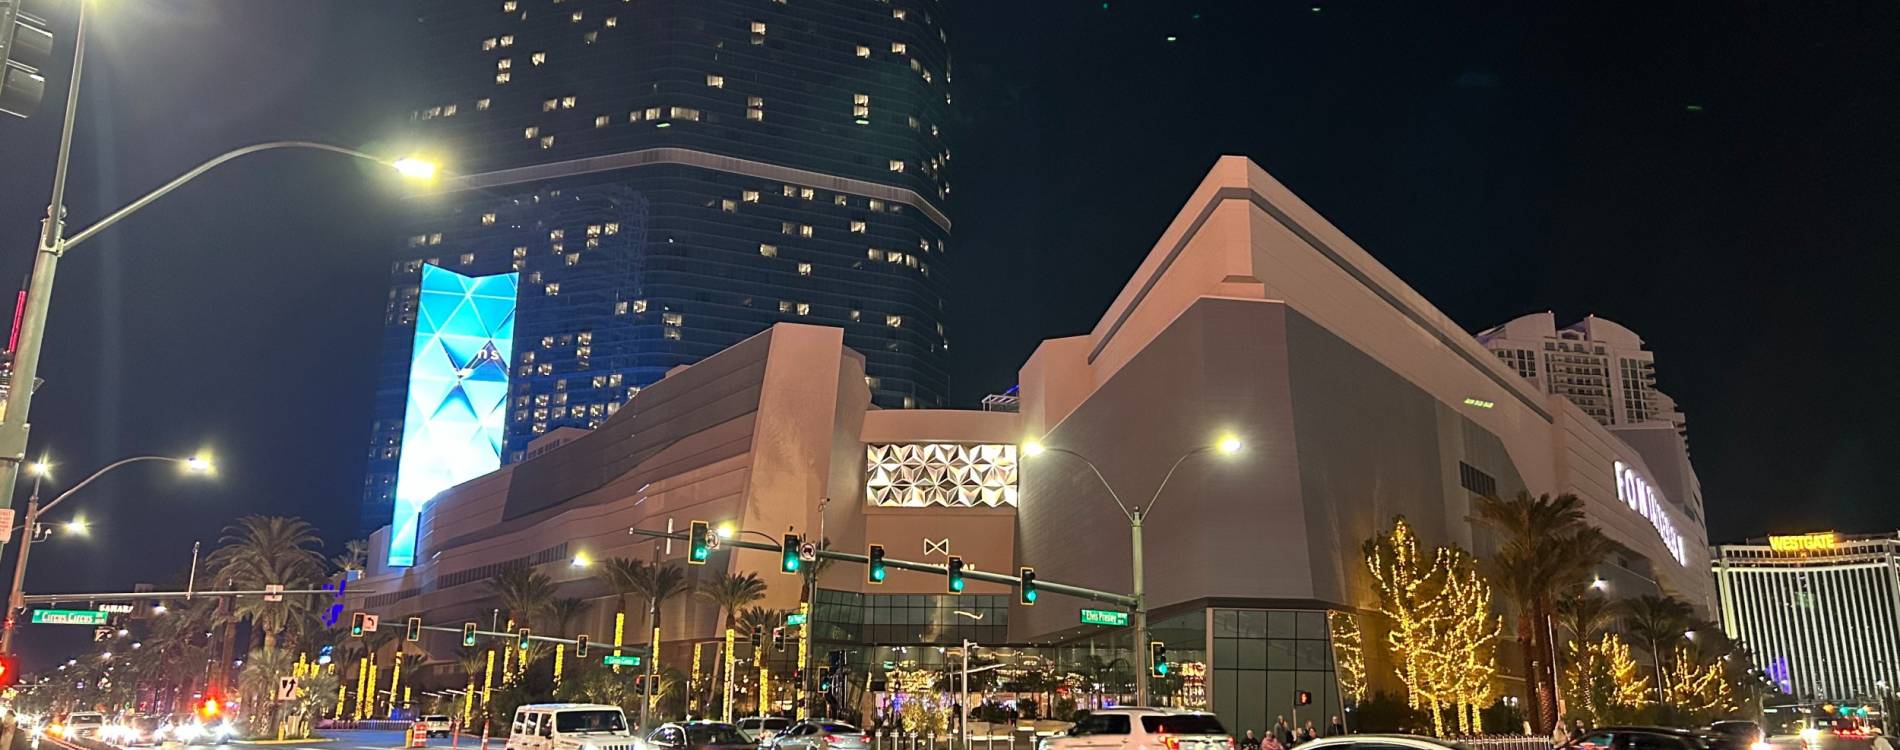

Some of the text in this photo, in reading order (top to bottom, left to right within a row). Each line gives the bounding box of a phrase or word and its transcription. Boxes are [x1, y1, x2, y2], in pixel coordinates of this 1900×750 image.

[1769, 534, 1835, 552] WESTGATE
[42, 612, 67, 623] Circus
[68, 612, 93, 624] Circus
